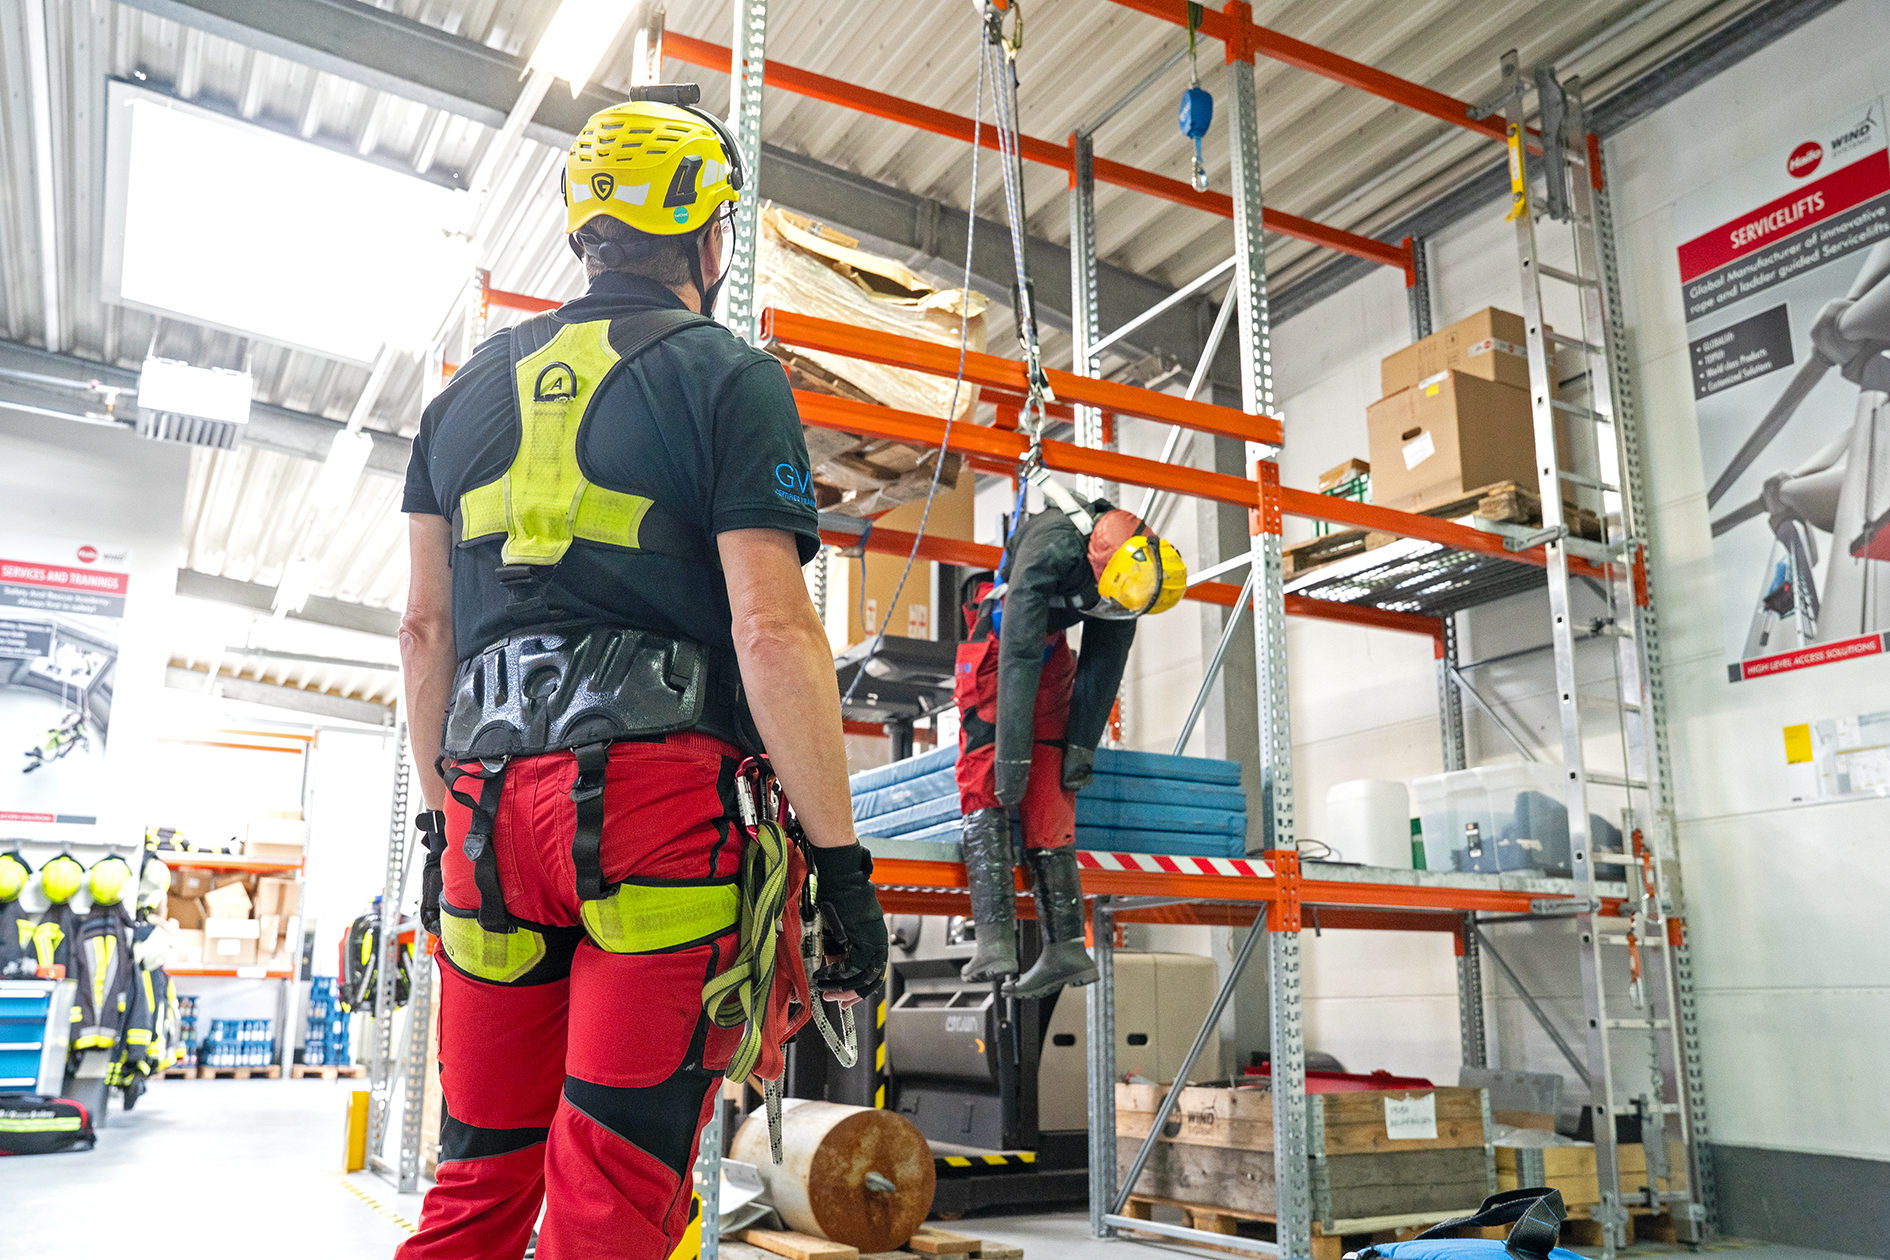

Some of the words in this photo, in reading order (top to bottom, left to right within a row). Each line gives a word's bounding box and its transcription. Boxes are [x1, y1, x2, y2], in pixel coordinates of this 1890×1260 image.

[1788, 149, 1822, 171] Hailo
[1831, 124, 1870, 149] WIND
[1730, 191, 1825, 249] SERVICELIFTS
[1689, 274, 1725, 299] Global
[1727, 241, 1802, 283] Manufacturer
[1804, 232, 1818, 248] of
[1820, 206, 1886, 241] innovative
[1690, 296, 1714, 315] rope
[1716, 284, 1738, 303] and
[1740, 270, 1776, 292] ladder
[1778, 250, 1820, 278] guided
[1822, 221, 1890, 257] Servicelifts
[1740, 348, 1768, 365] Products
[1742, 361, 1773, 378] Solutions
[550, 377, 562, 390] A
[775, 463, 815, 497] GW
[1, 565, 45, 582] SERVICES
[47, 570, 69, 584] AND
[69, 572, 119, 590] TRAININGS
[1747, 663, 1768, 675] HIGH
[1770, 658, 1792, 671] LEVEL
[1793, 651, 1825, 666] ACCESS
[1826, 641, 1876, 659] SOLUTIONS
[1187, 1111, 1215, 1126] WIND
